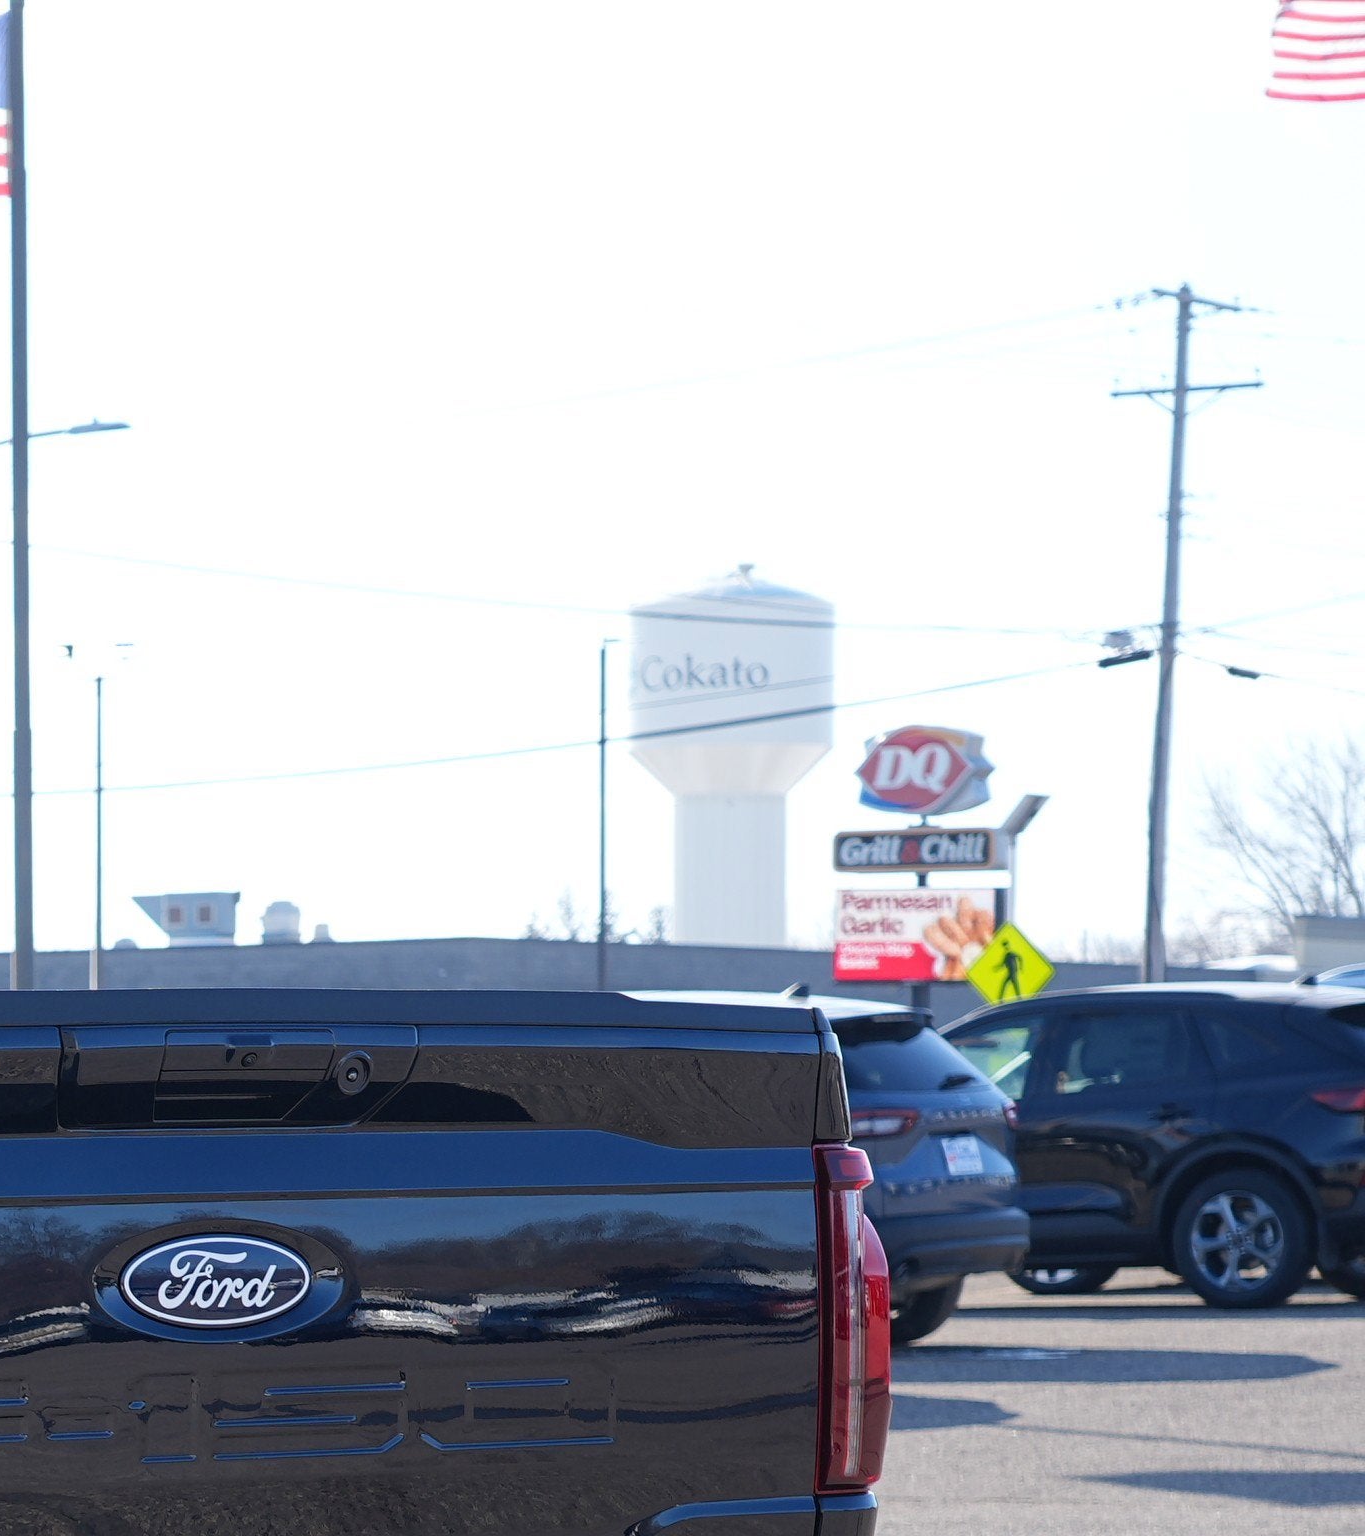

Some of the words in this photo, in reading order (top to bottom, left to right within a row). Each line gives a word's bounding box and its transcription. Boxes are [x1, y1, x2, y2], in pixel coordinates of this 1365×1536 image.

[641, 653, 769, 692] Cokato
[873, 743, 951, 794] DQ
[840, 834, 902, 866] Grill
[920, 832, 986, 864] Chill
[841, 891, 953, 911] Parmesan
[840, 915, 903, 935] Garlic
[158, 1250, 277, 1309] Ford
